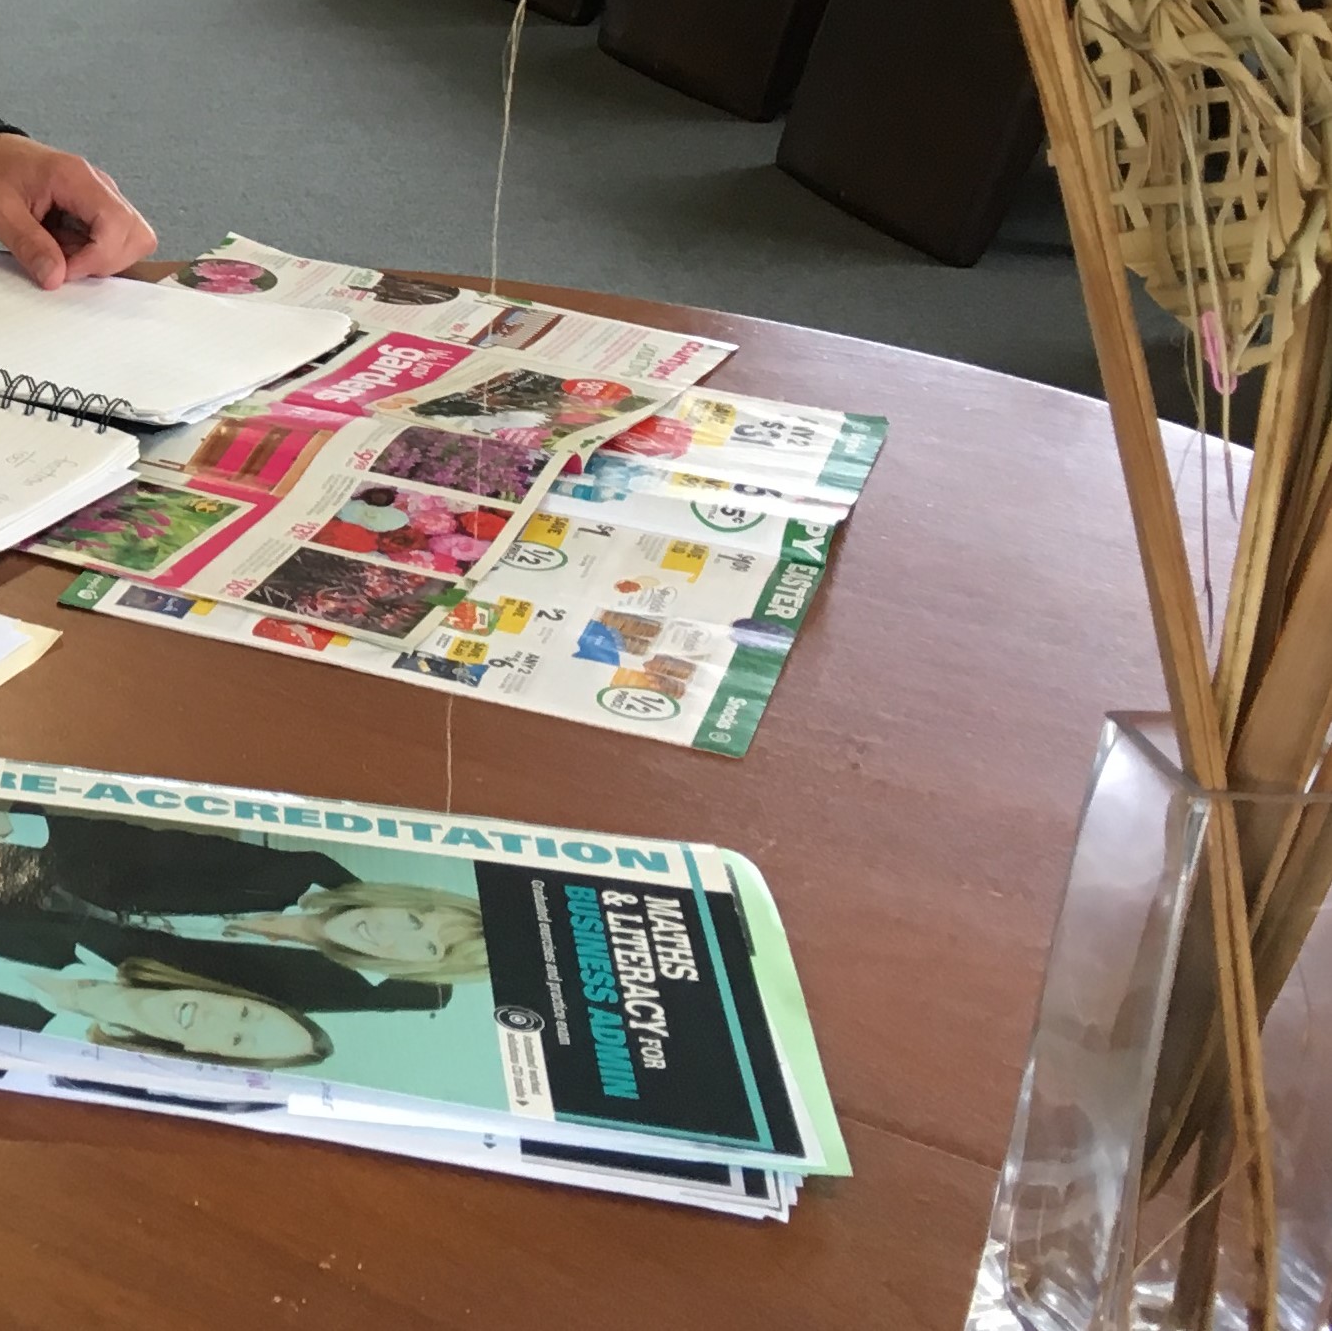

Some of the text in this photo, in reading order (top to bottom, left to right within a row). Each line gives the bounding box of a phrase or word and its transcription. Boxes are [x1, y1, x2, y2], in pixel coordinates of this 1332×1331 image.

[313, 343, 425, 404] gardens
[647, 341, 704, 381] courtyard
[517, 548, 555, 566] 1/2
[765, 562, 820, 619] EASTER
[525, 652, 541, 670] ANY
[609, 690, 630, 709] PRICE
[624, 696, 665, 713] 1/2
[715, 696, 749, 730] Snacks
[644, 895, 699, 982] MATHS
[531, 880, 571, 1046] Graduated exercises and practice exam
[601, 889, 670, 1070] & LITERACY FOR
[564, 884, 639, 1100] BUSINESS ADMIN
